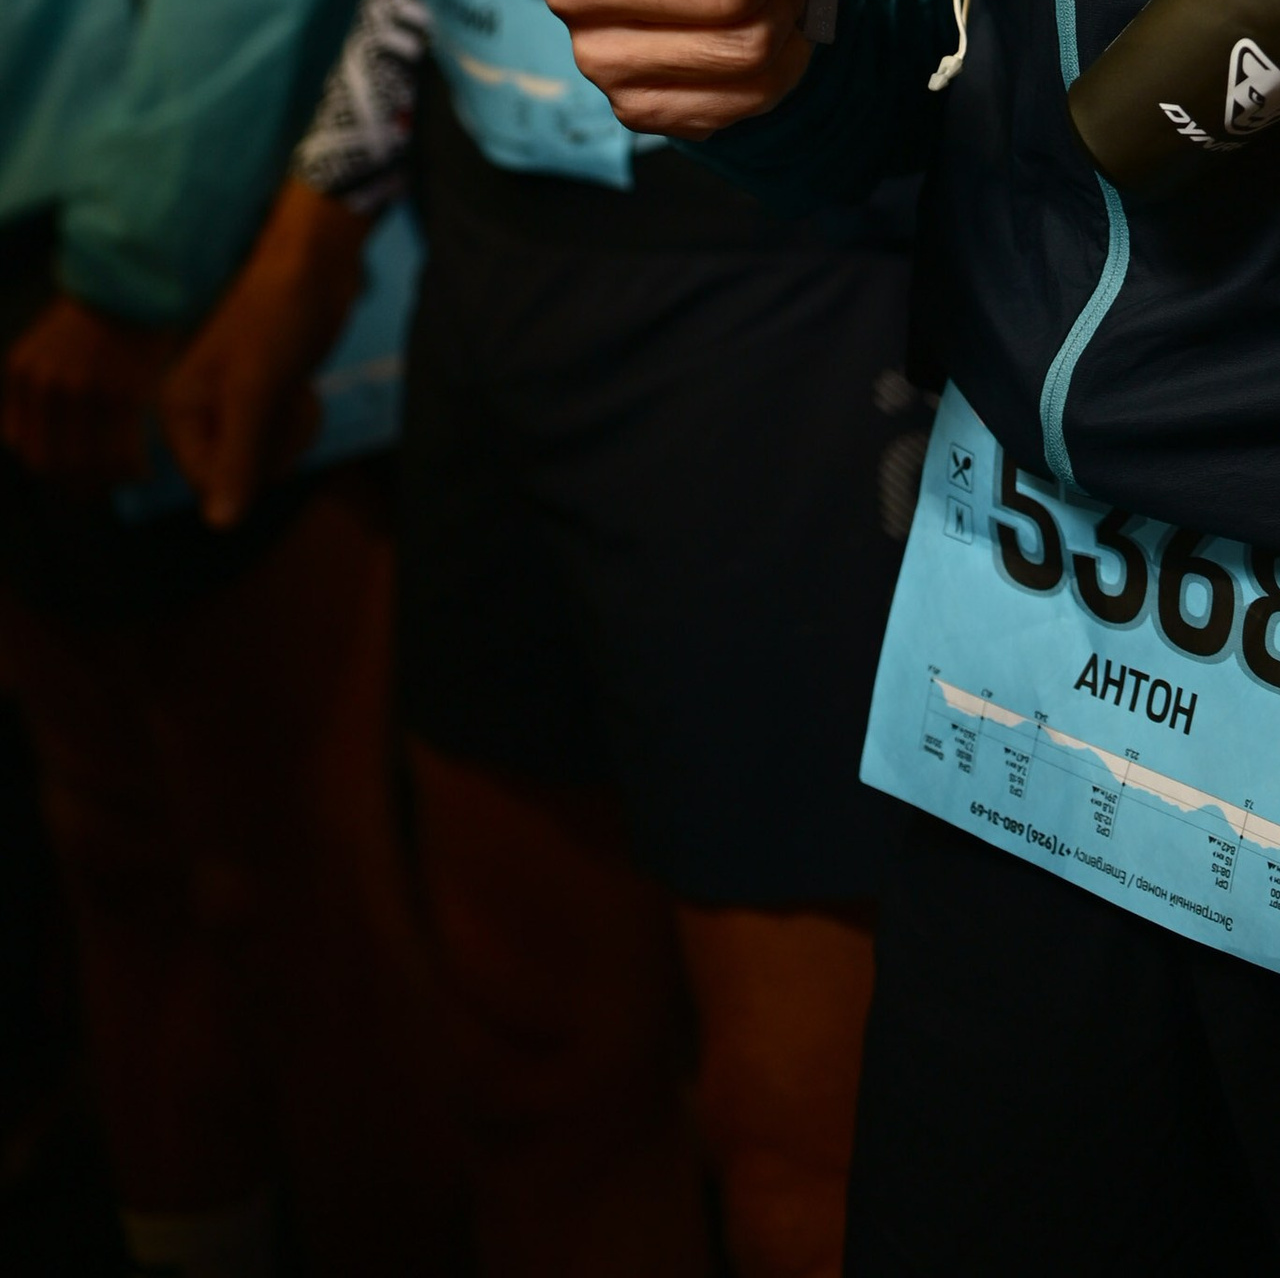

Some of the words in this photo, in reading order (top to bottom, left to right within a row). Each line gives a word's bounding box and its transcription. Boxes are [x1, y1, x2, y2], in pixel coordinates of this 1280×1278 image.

[1073, 653, 1198, 736] АНТОН
[1244, 799, 1254, 810] 7,5
[970, 800, 1025, 836] 680-31-69
[1026, 823, 1058, 855] (926)
[1058, 843, 1072, 857] +7
[1221, 845, 1236, 855] 842
[1073, 847, 1127, 885] Emergency
[1211, 863, 1231, 878] 08:15
[1225, 856, 1233, 867] 15
[1136, 876, 1168, 900] номер
[1169, 892, 1234, 932] Экстренный
